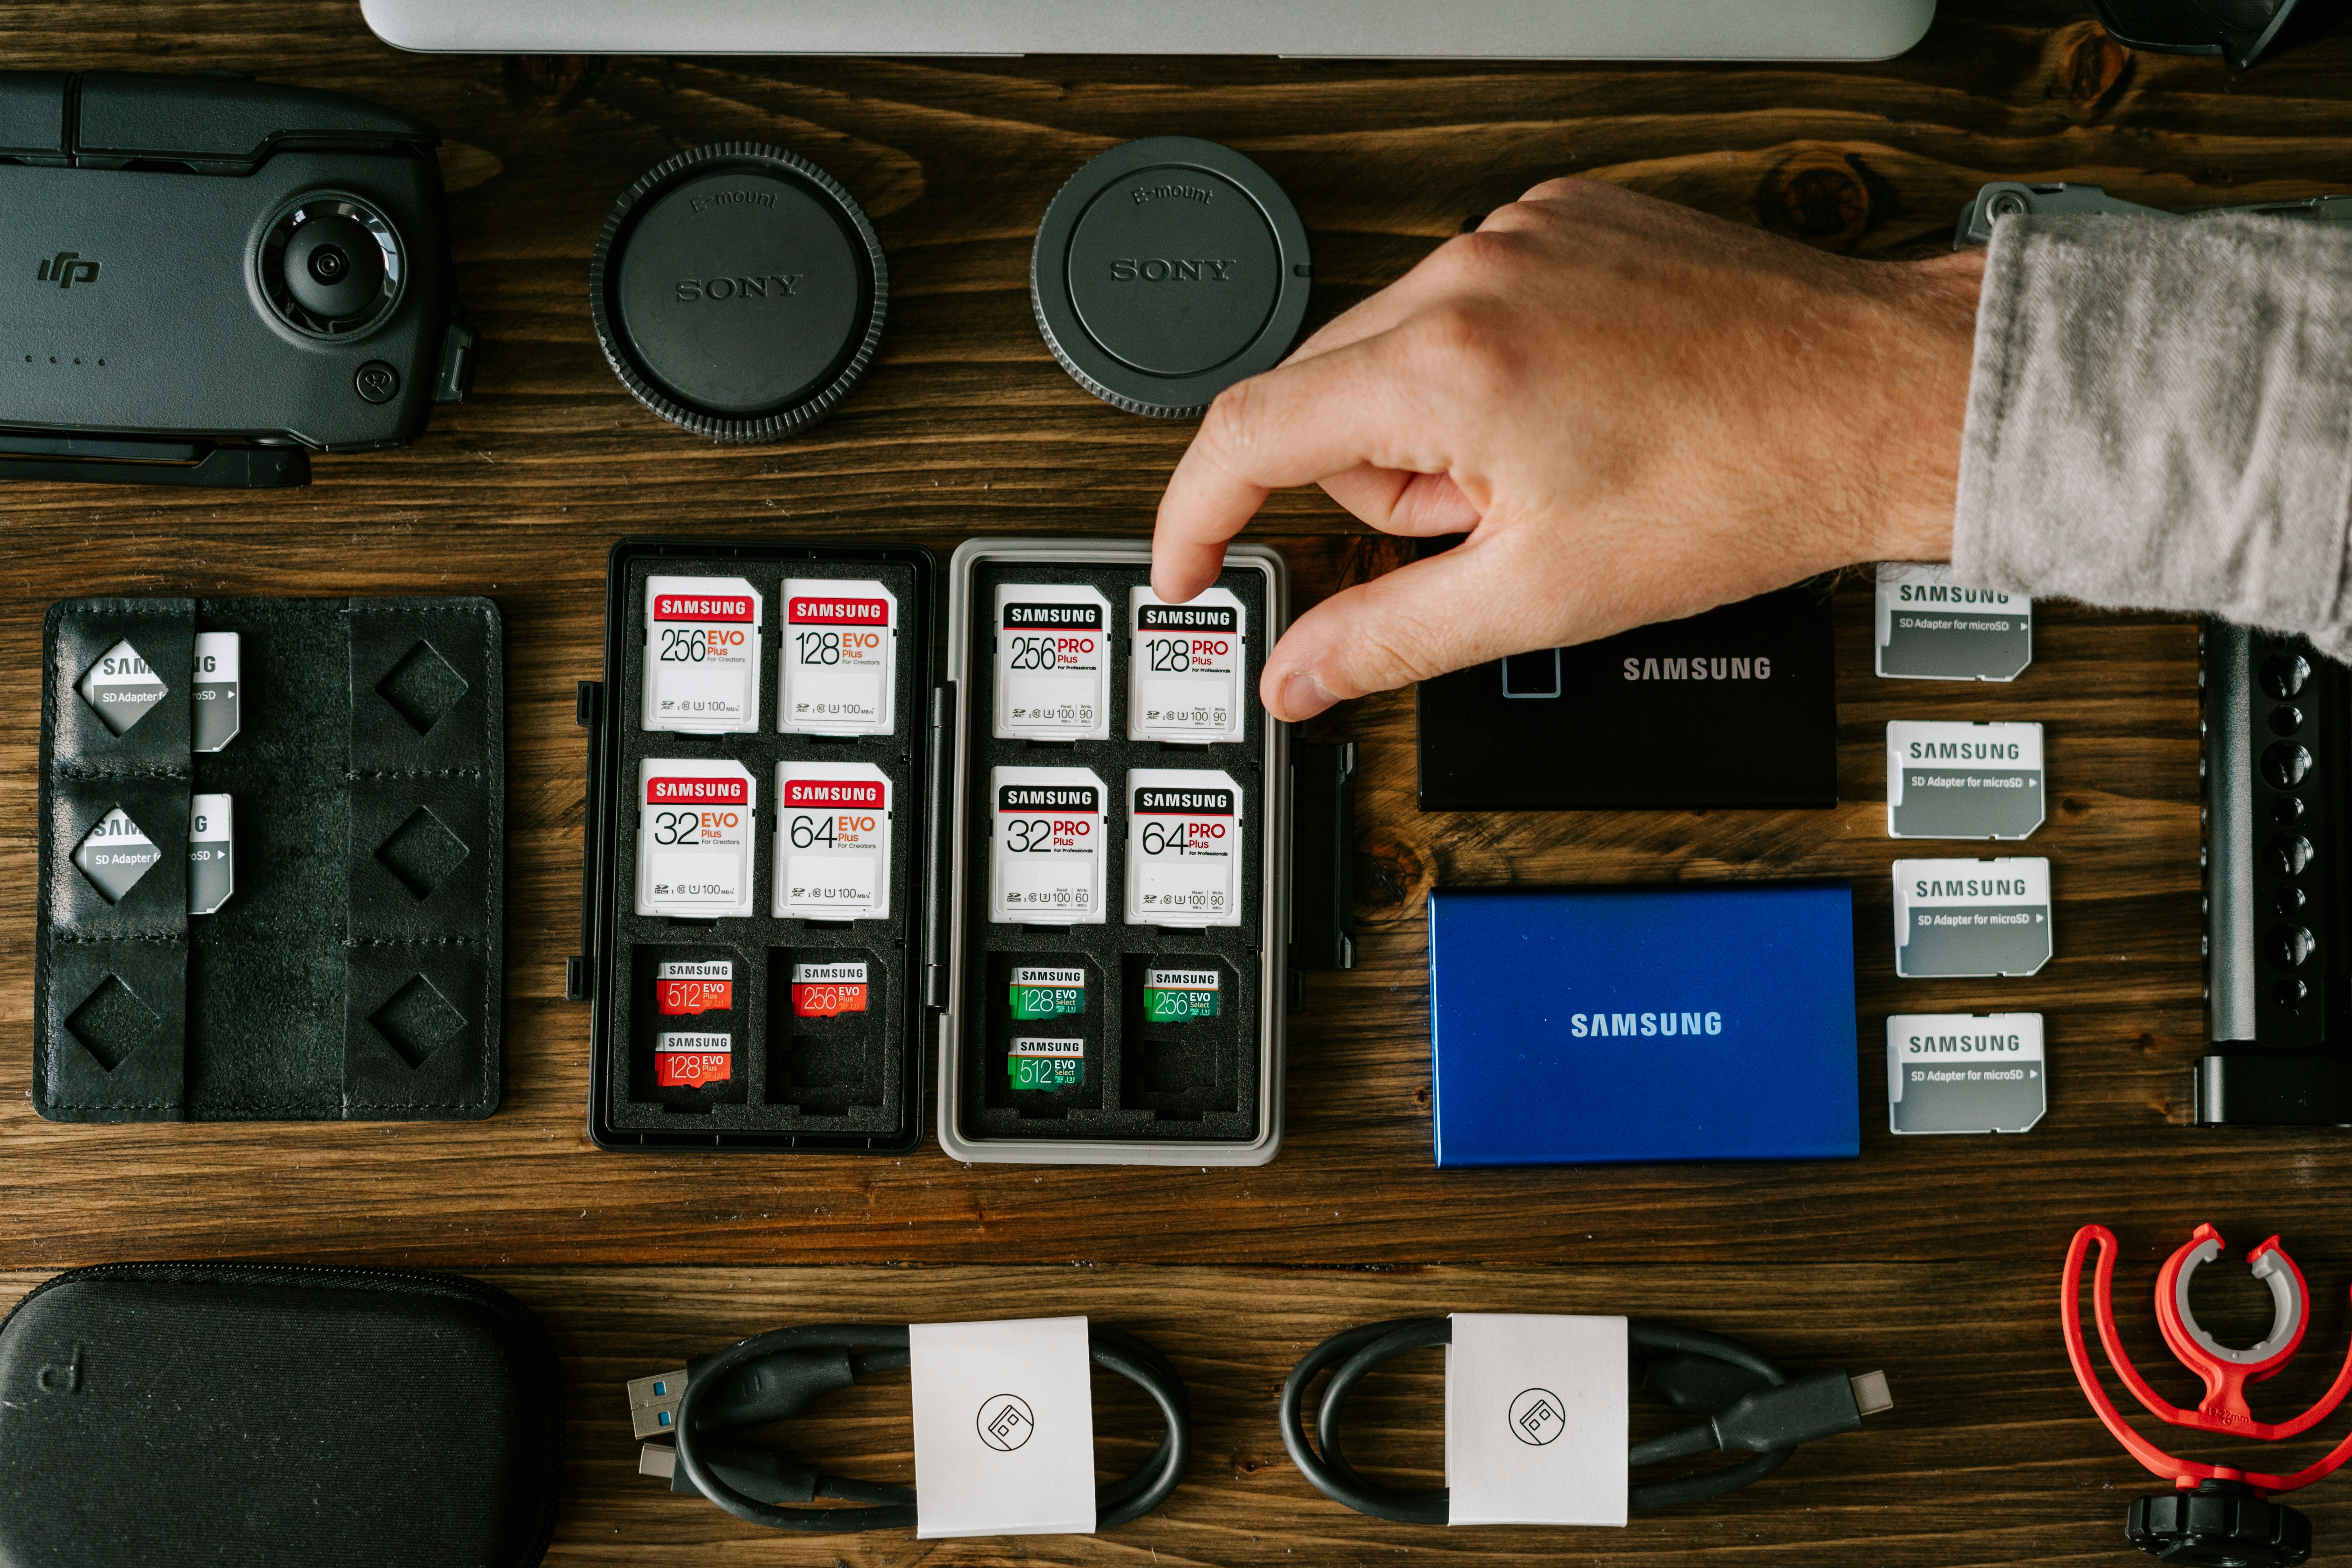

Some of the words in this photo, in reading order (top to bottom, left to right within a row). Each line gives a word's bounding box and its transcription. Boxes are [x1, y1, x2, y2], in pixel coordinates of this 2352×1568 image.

[690, 190, 777, 213] E-mount
[1132, 185, 1213, 205] E-mount
[1110, 259, 1236, 281] SONY
[675, 274, 803, 302] SONY
[1900, 584, 2008, 604] SAMSUNG
[662, 600, 745, 615] SAMSUNG
[797, 603, 880, 618] SAMSUNG
[1012, 608, 1095, 622] SAMSUNG
[1146, 610, 1230, 625] SAMSUNG
[1899, 618, 1913, 628] SD
[1914, 619, 1952, 630] Adapter
[1954, 619, 1967, 629] for
[1969, 621, 2009, 631] microSD
[660, 629, 706, 662] 256
[708, 630, 744, 645] EVO
[708, 647, 727, 655] Plus
[796, 632, 839, 665] 128
[843, 633, 879, 648] EVO
[842, 650, 862, 658] Plus
[1011, 637, 1055, 670] 256
[1058, 638, 1094, 653] PRO
[1146, 639, 1189, 672] 128
[1192, 640, 1228, 655] PRO
[1192, 657, 1212, 665] Plus
[1624, 657, 1771, 680] SAMSUNG
[103, 693, 117, 702] SD
[118, 692, 157, 703] Adapter
[192, 690, 216, 700] roSD
[708, 701, 725, 711] 100
[842, 704, 860, 714] 100
[1057, 710, 1074, 718] 100
[1080, 710, 1092, 719] 90
[1191, 712, 1208, 721] 100
[1213, 712, 1226, 721] 90
[1910, 742, 2019, 759] SAMSUNG
[1912, 776, 1925, 787] SD
[1927, 776, 1965, 788] Adapter
[1967, 777, 1981, 787] for
[1983, 777, 2023, 788] microSD
[656, 783, 740, 797] SAMSUNG
[792, 787, 876, 801] SAMSUNG
[1008, 791, 1092, 804] SAMSUNG
[1143, 793, 1227, 808] SAMSUNG
[655, 812, 699, 845] 32
[702, 813, 738, 828] EVO
[701, 830, 721, 838] Plus
[791, 815, 837, 848] 64
[839, 817, 875, 831] EVO
[839, 833, 859, 841] Plus
[1007, 820, 1051, 852] 32
[1054, 821, 1090, 835] PRO
[1142, 822, 1189, 855] 64
[1189, 823, 1225, 838] PRO
[1189, 840, 1209, 848] Plus
[96, 855, 109, 865] SD
[112, 854, 151, 865] Adapter
[702, 885, 720, 894] 100
[838, 889, 856, 898] 100
[1916, 879, 2025, 897] SAMSUNG
[1053, 893, 1070, 902] 100
[1076, 893, 1088, 902] 60
[1188, 895, 1205, 905] 100
[1211, 896, 1223, 905] 90
[1918, 915, 1932, 925] SD
[1934, 914, 1972, 927] Adapter
[1974, 914, 1988, 925] for
[1990, 913, 2030, 924] microSD
[670, 965, 728, 975] SAMSUNG
[805, 968, 863, 978] SAMSUNG
[1022, 971, 1080, 981] SAMSUNG
[1156, 974, 1214, 984] SAMSUNG
[669, 983, 700, 1007] 512
[703, 984, 724, 992] EVO
[804, 987, 836, 1009] 256
[839, 987, 859, 996] EVO
[1021, 989, 1054, 1012] 128
[1056, 990, 1077, 999] EVO
[1155, 992, 1187, 1015] 256
[1190, 992, 1211, 1002] EVO
[1571, 1012, 1722, 1037] SAMSUNG
[669, 1037, 727, 1047] SAMSUNG
[1021, 1042, 1079, 1052] SAMSUNG
[1910, 1035, 2019, 1053] SAMSUNG
[668, 1056, 700, 1078] 128
[703, 1056, 723, 1065] EVO
[1020, 1060, 1051, 1083] 512
[1055, 1060, 1075, 1069] EVO
[1911, 1071, 1925, 1082] SD
[1927, 1070, 1965, 1083] Adapter
[1967, 1070, 1981, 1080] for
[1984, 1069, 2024, 1080] microSD
